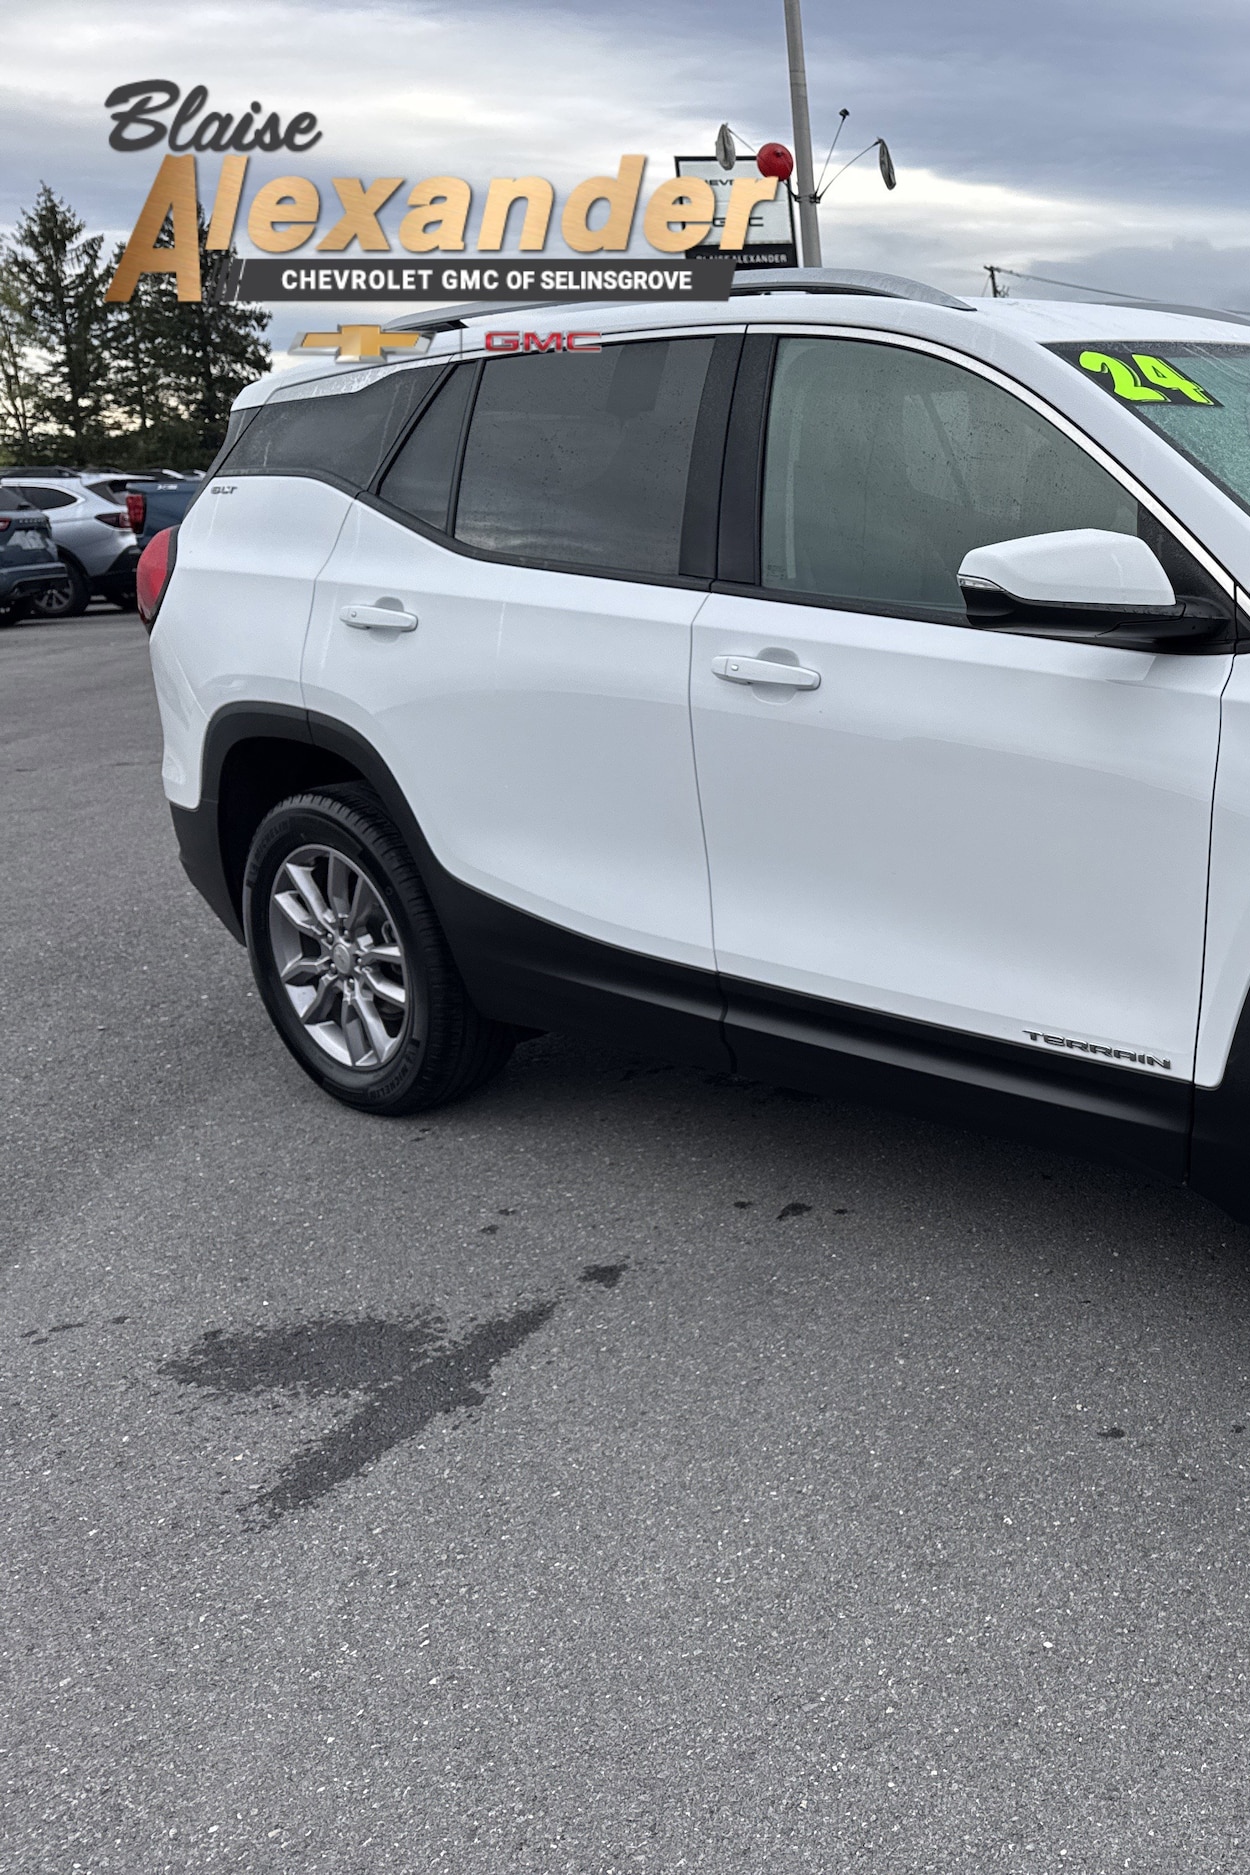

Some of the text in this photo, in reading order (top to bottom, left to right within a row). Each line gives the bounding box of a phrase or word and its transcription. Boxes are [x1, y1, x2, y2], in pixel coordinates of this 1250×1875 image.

[712, 216, 764, 227] GC
[1079, 351, 1216, 405] 24
[1022, 1029, 1172, 1070] TERRAIN
